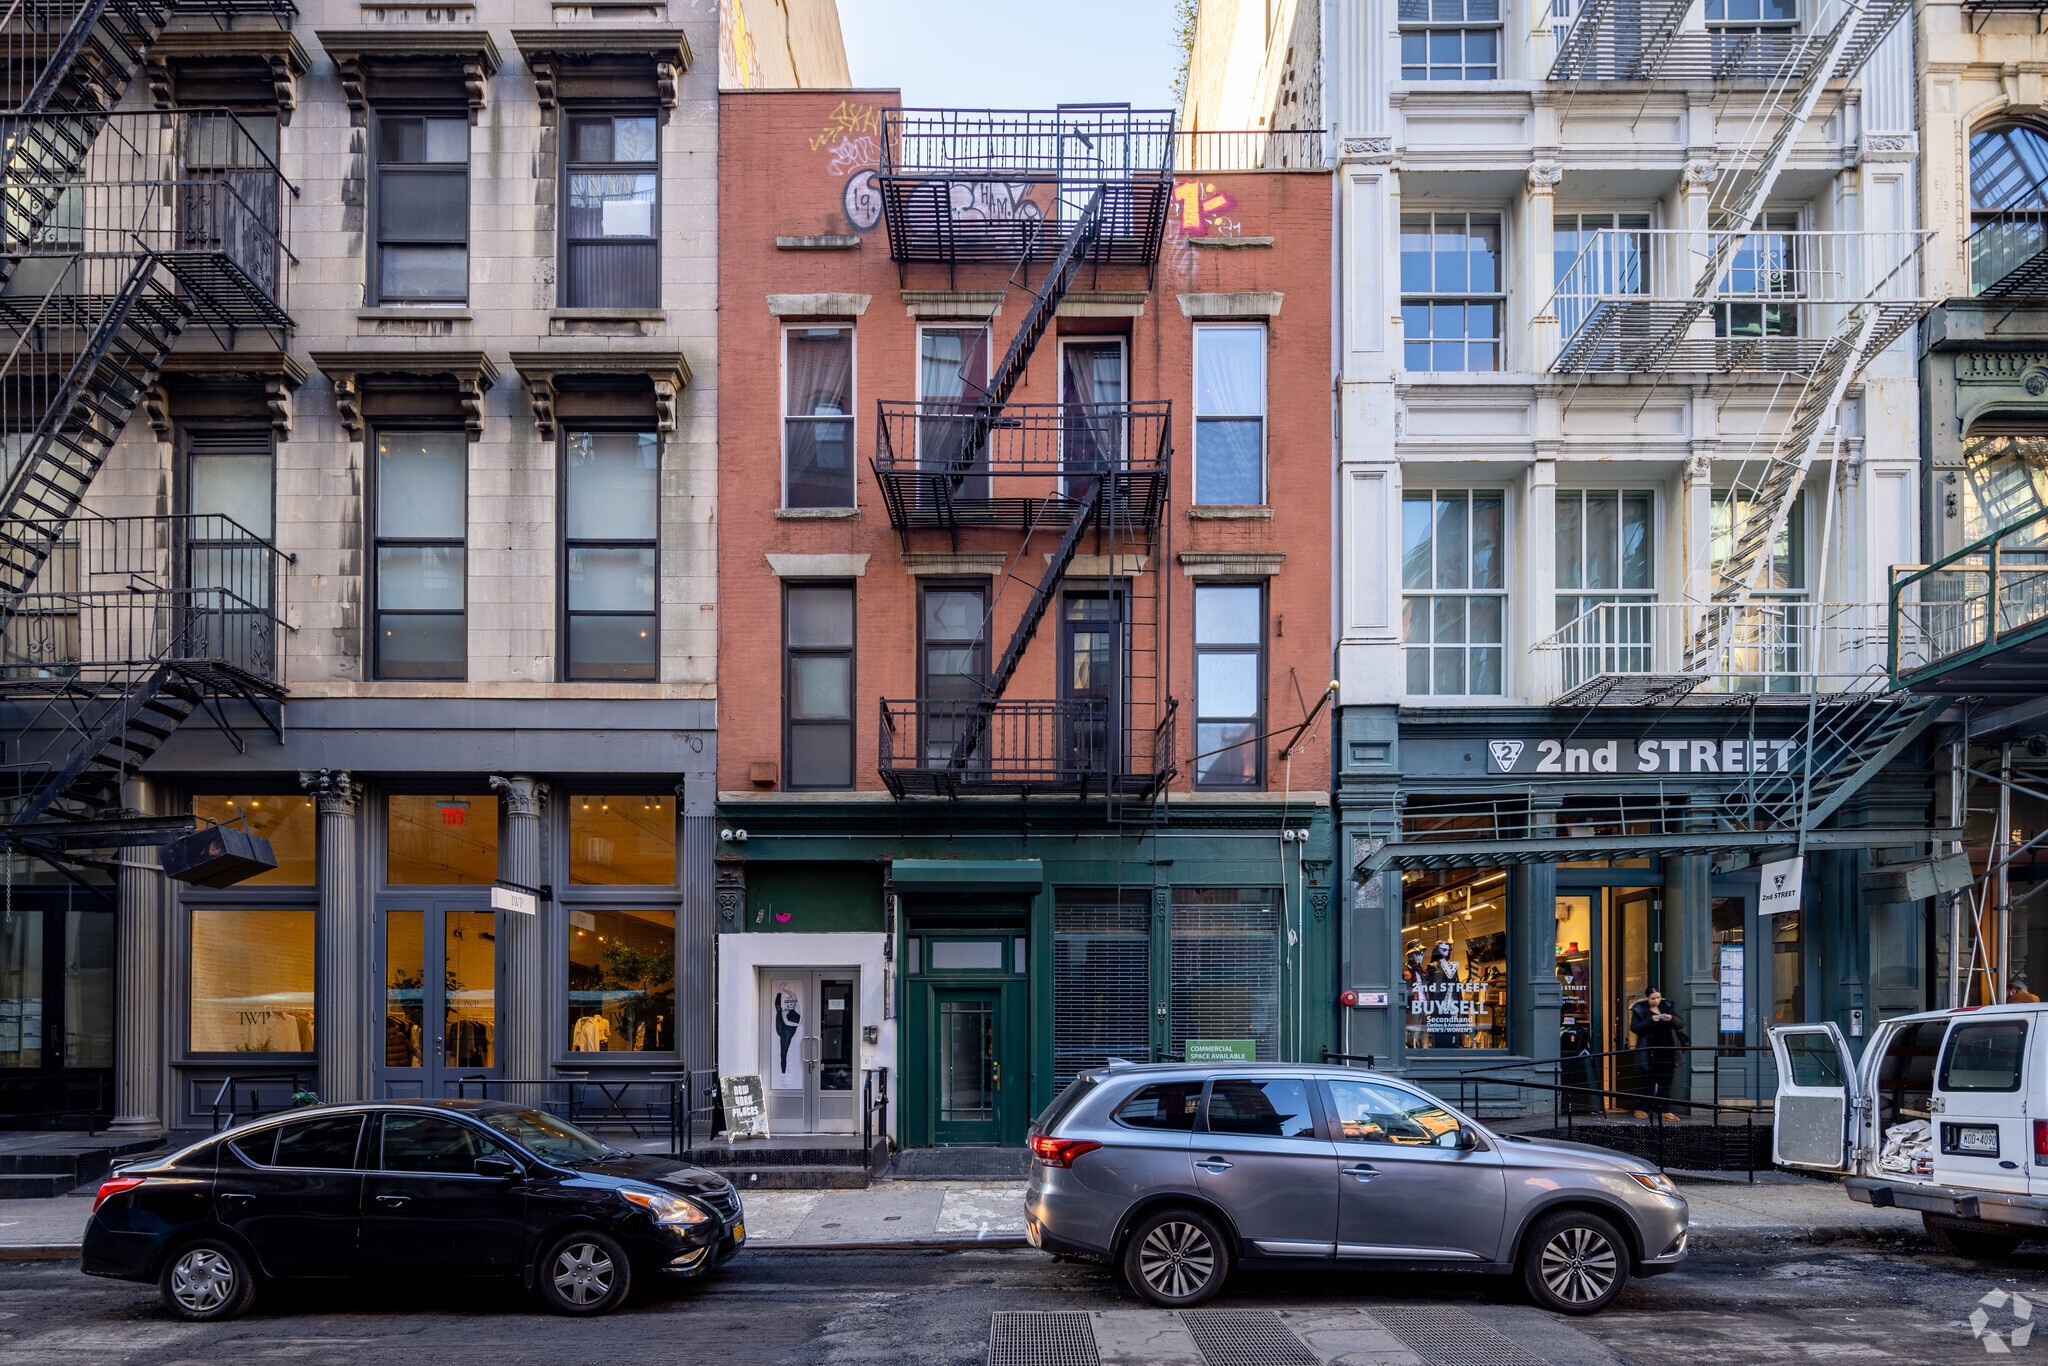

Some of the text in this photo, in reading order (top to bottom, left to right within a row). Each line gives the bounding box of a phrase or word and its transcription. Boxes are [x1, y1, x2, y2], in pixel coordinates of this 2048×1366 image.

[1536, 740, 1797, 773] 2nd STREET
[1774, 890, 1796, 899] STREET
[510, 895, 524, 908] TWP
[1412, 983, 1488, 992] 2nd STREET
[1411, 1000, 1445, 1014] BUY
[1449, 1000, 1489, 1014] SELL
[236, 1011, 271, 1025] TWP
